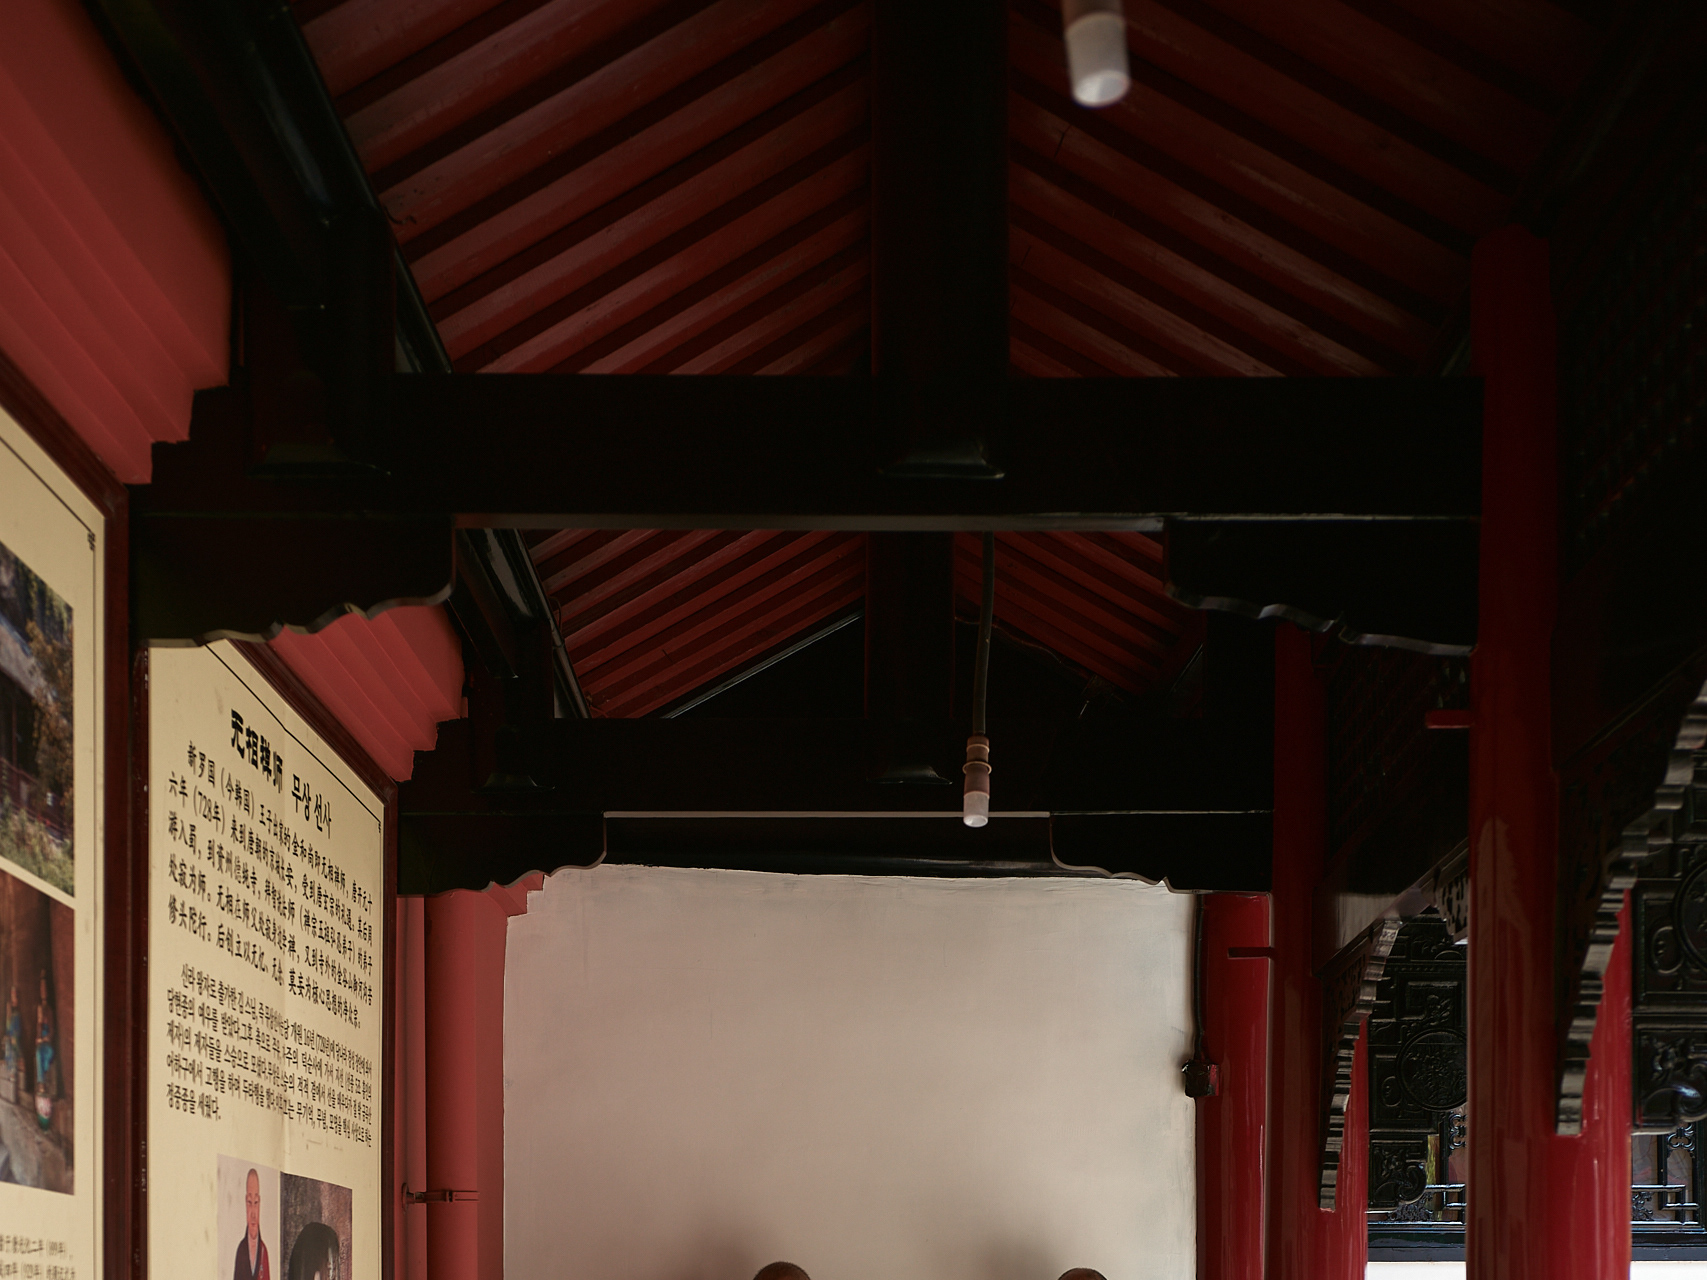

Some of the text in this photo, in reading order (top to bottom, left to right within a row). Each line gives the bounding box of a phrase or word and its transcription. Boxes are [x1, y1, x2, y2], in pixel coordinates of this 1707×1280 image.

[230, 708, 332, 840] 无相禅师 무상 선사
[181, 963, 195, 993] 신라
[196, 970, 217, 1000] 왕자로
[218, 981, 237, 1012] 출가한
[194, 1030, 222, 1064] 제자들을
[224, 1043, 249, 1071] 스승으로
